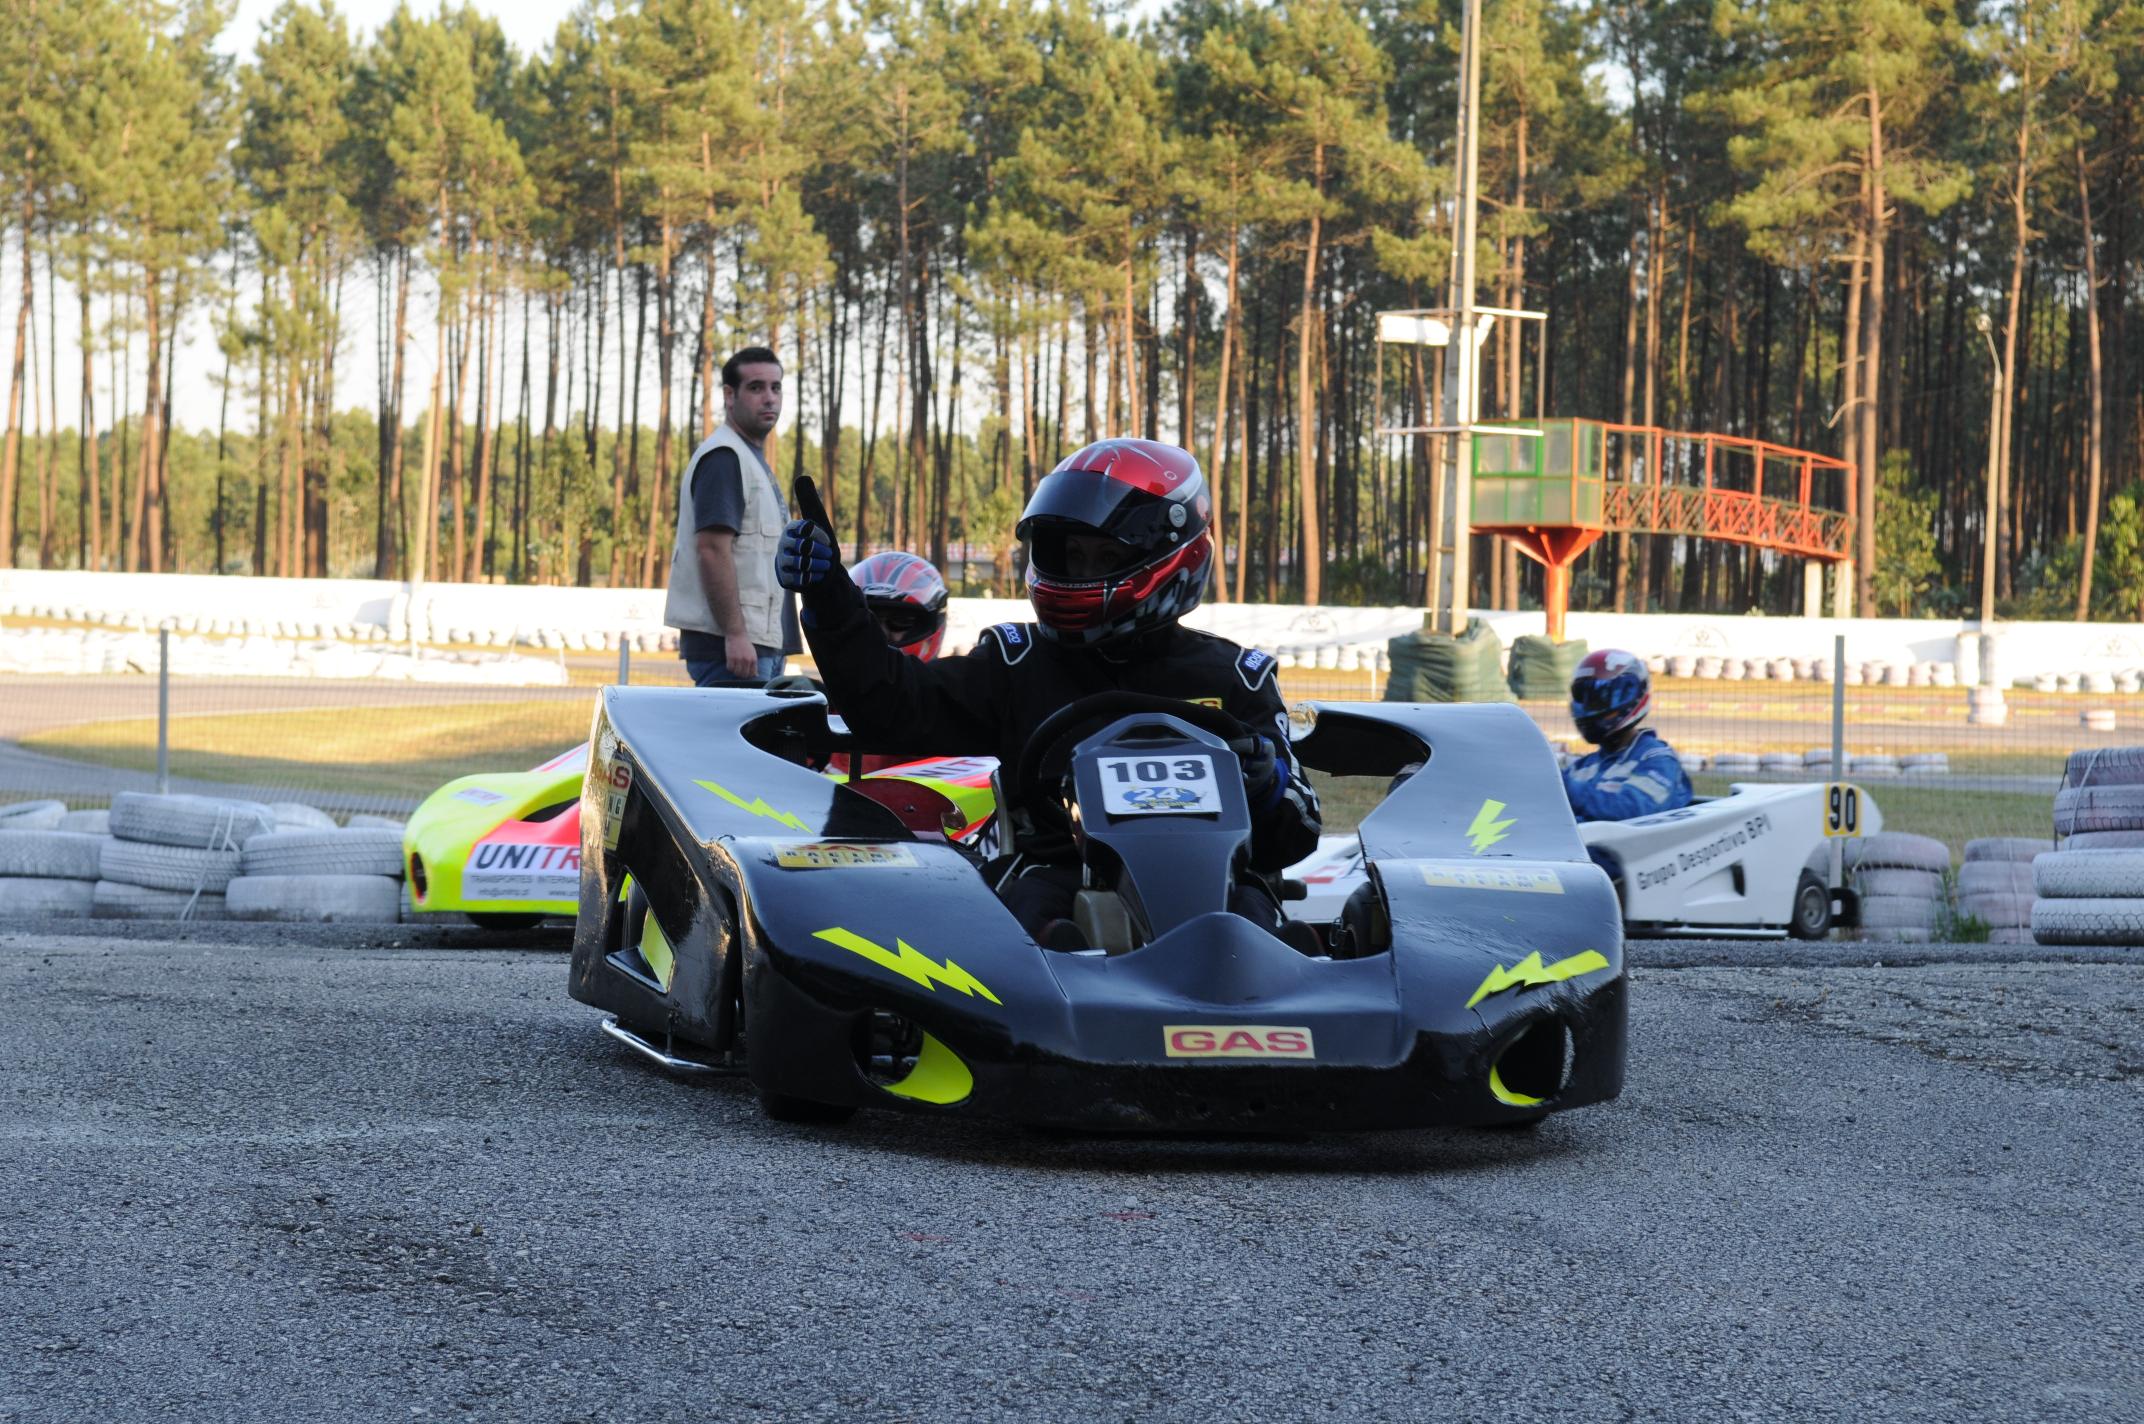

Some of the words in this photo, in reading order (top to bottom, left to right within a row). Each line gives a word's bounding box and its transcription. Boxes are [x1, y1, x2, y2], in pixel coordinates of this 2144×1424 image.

[1107, 760, 1206, 783] 103
[1828, 786, 1856, 832] 90
[476, 844, 580, 870] UNITR
[1637, 862, 1677, 890] Grupo
[1678, 830, 1747, 872] Desportivo
[1171, 1031, 1308, 1053] GAS
